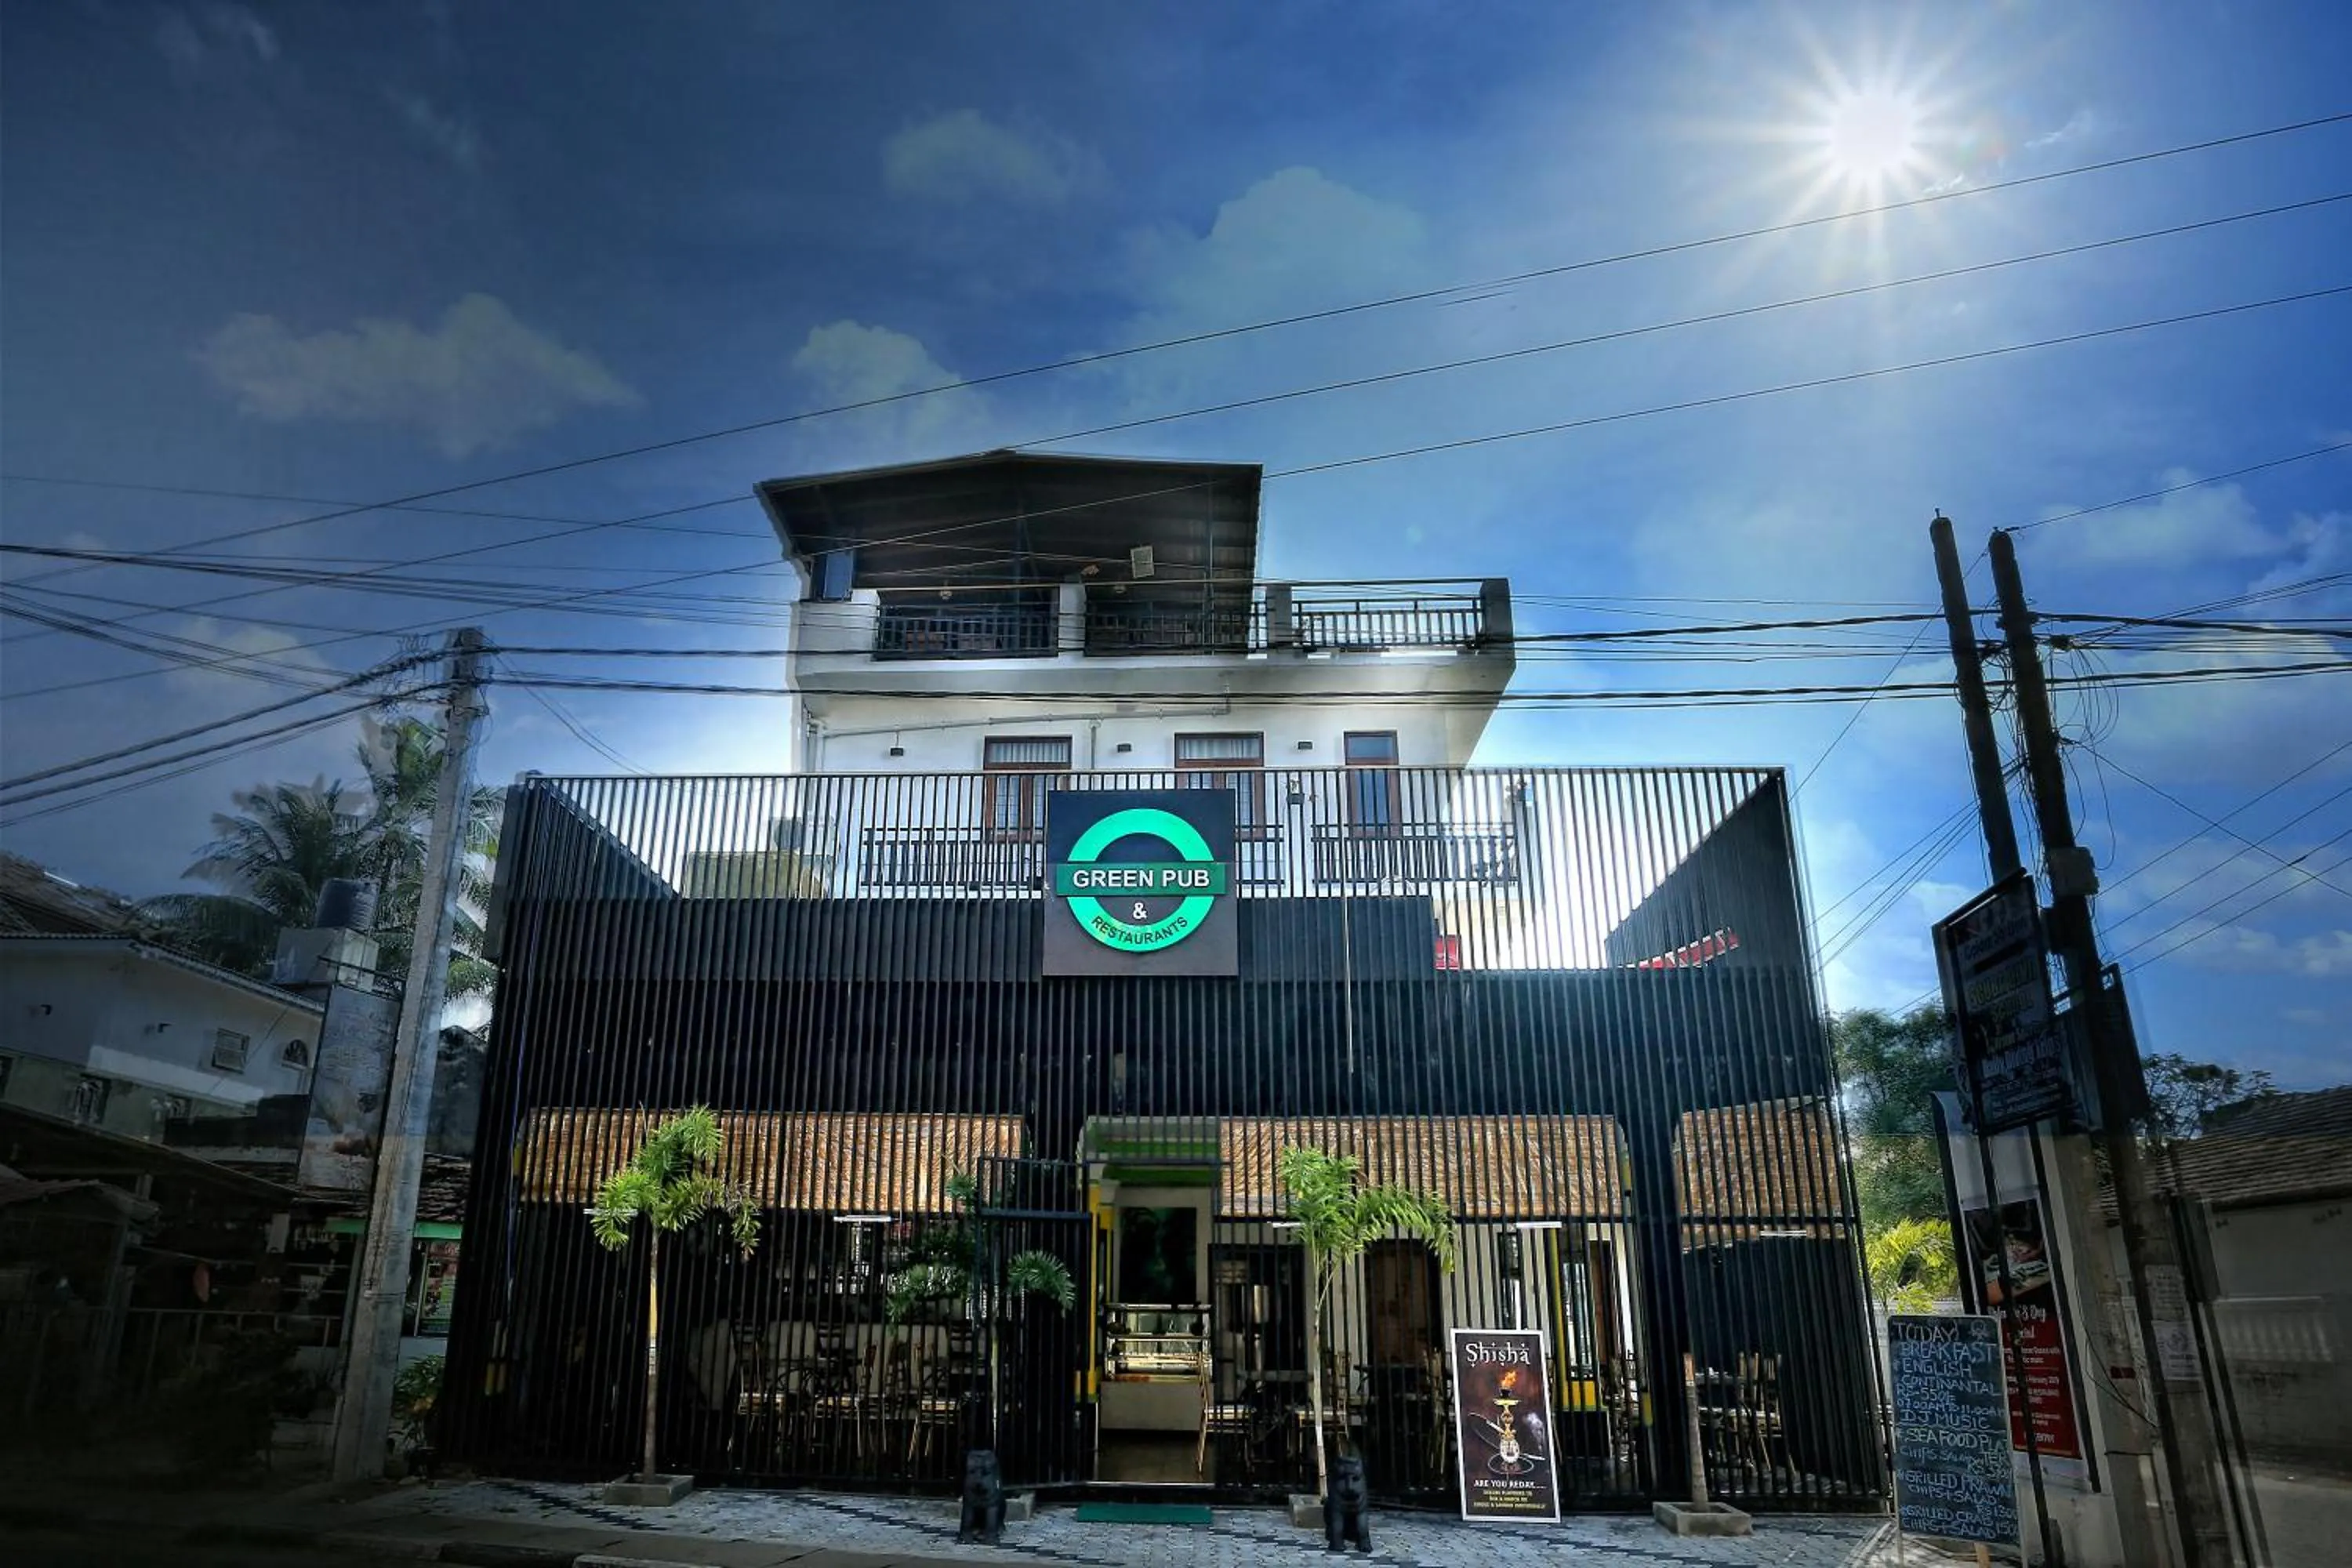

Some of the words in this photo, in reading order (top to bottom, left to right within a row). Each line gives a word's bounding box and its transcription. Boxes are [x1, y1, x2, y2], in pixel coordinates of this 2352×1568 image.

[1073, 869, 1154, 887] GREEN
[1162, 869, 1210, 887] PUB
[1132, 902, 1147, 920] &
[1091, 916, 1189, 945] RESTAURANTS
[1465, 1341, 1530, 1367] Shisha
[1900, 1341, 1997, 1363] BREAKFAST
[1902, 1357, 1973, 1378] ENGLISH
[1900, 1409, 1933, 1423] DJ
[1935, 1411, 1991, 1429] MUSIC
[1490, 1479, 1508, 1488] YOU
[1906, 1470, 1958, 1489] GRILLED
